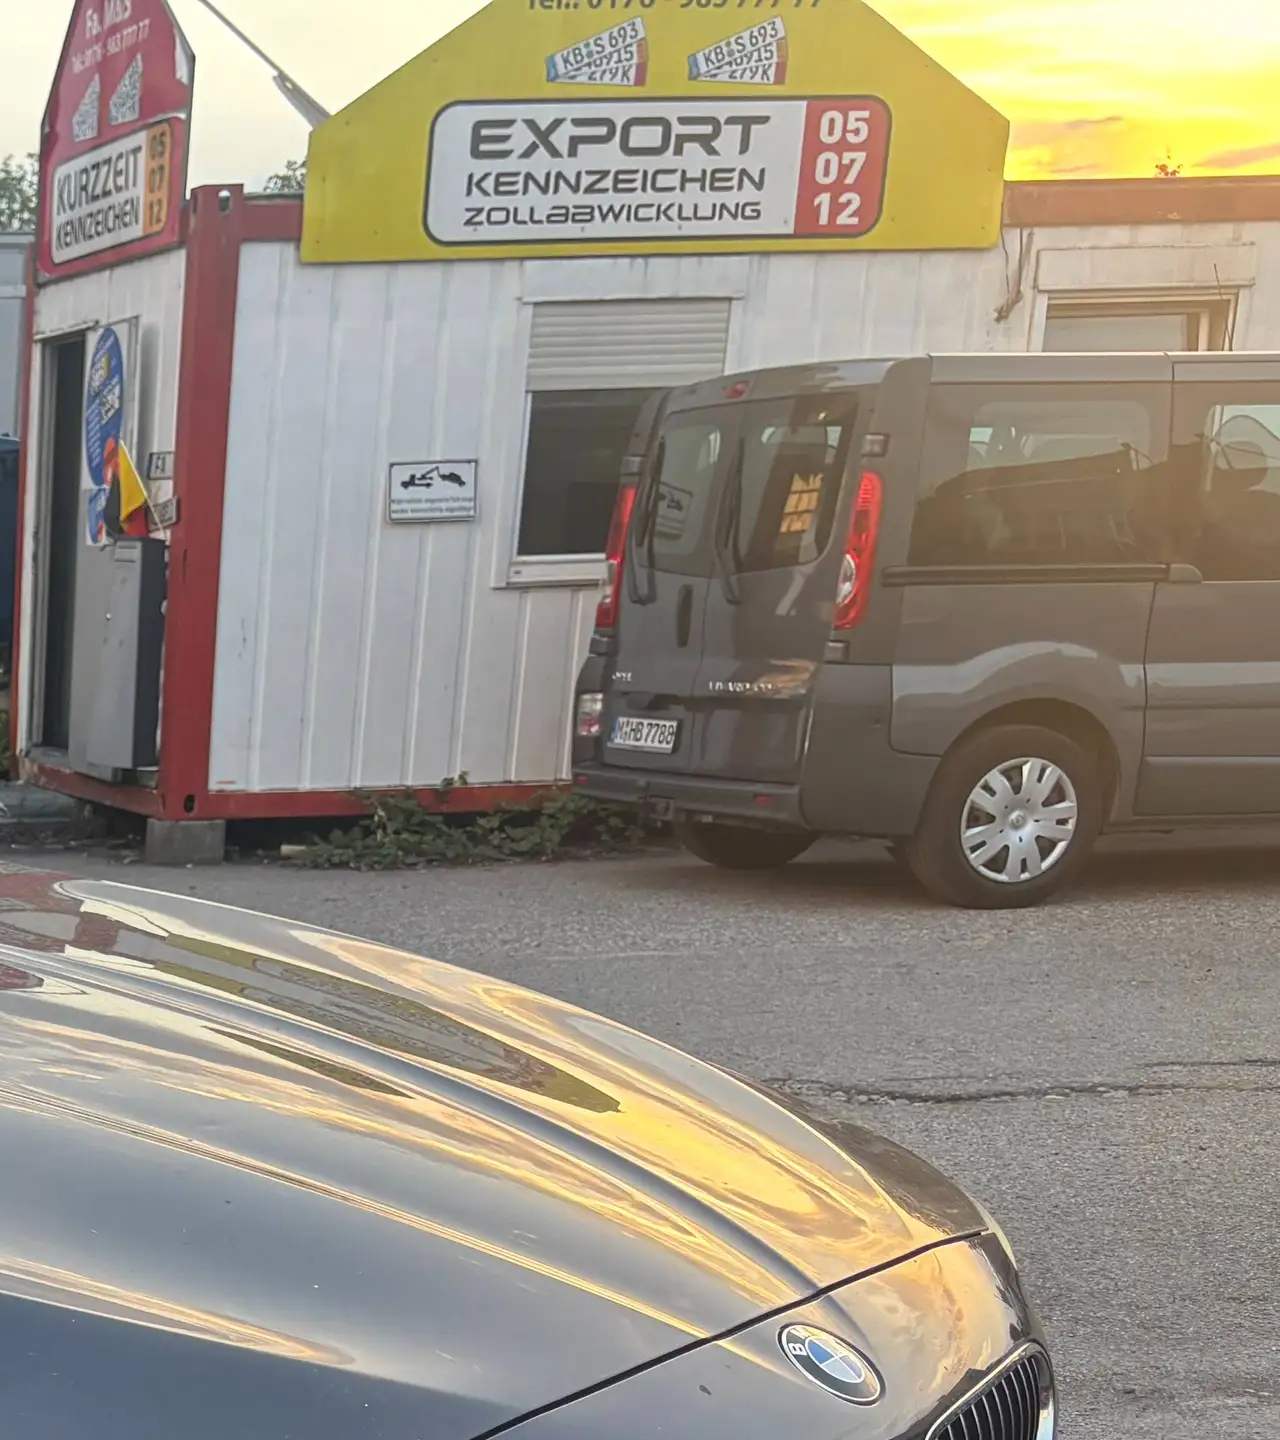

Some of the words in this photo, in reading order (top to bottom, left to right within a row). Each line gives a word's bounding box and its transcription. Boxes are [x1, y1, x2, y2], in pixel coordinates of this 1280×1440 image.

[469, 115, 772, 161] EXPORT
[818, 109, 871, 144] 05
[149, 131, 167, 161] 05
[55, 145, 143, 217] KURZZEIT
[148, 164, 166, 195] 07
[465, 167, 766, 198] KENNZEICHEN
[814, 151, 868, 185] 07
[55, 196, 140, 251] KENNZEICHEN
[149, 198, 163, 227] 12
[812, 191, 862, 226] 12
[644, 722, 675, 745] 7788
